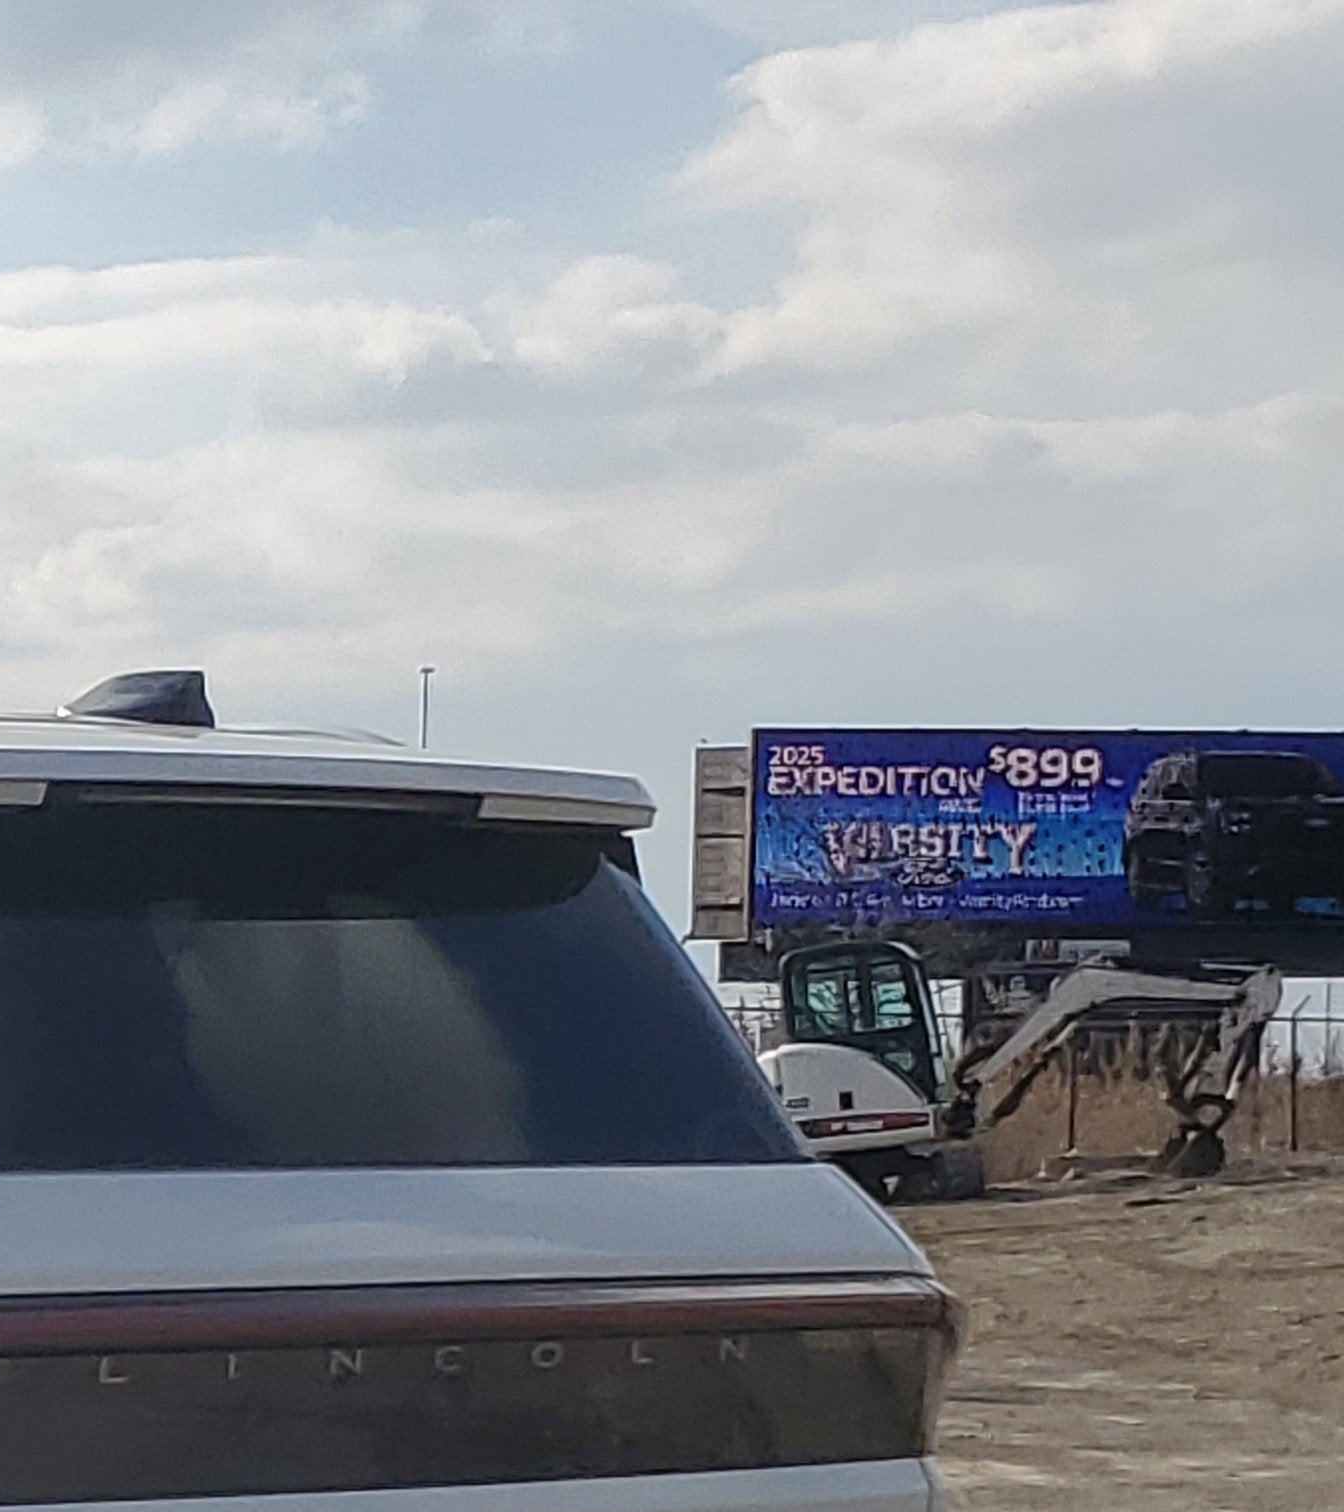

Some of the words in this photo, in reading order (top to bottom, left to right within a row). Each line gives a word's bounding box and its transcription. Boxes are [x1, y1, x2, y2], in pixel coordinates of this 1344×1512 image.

[768, 745, 825, 765] 2025
[988, 744, 1103, 788] $899
[767, 765, 986, 797] EXPEDITION
[98, 1338, 749, 1383] LINCOLN
